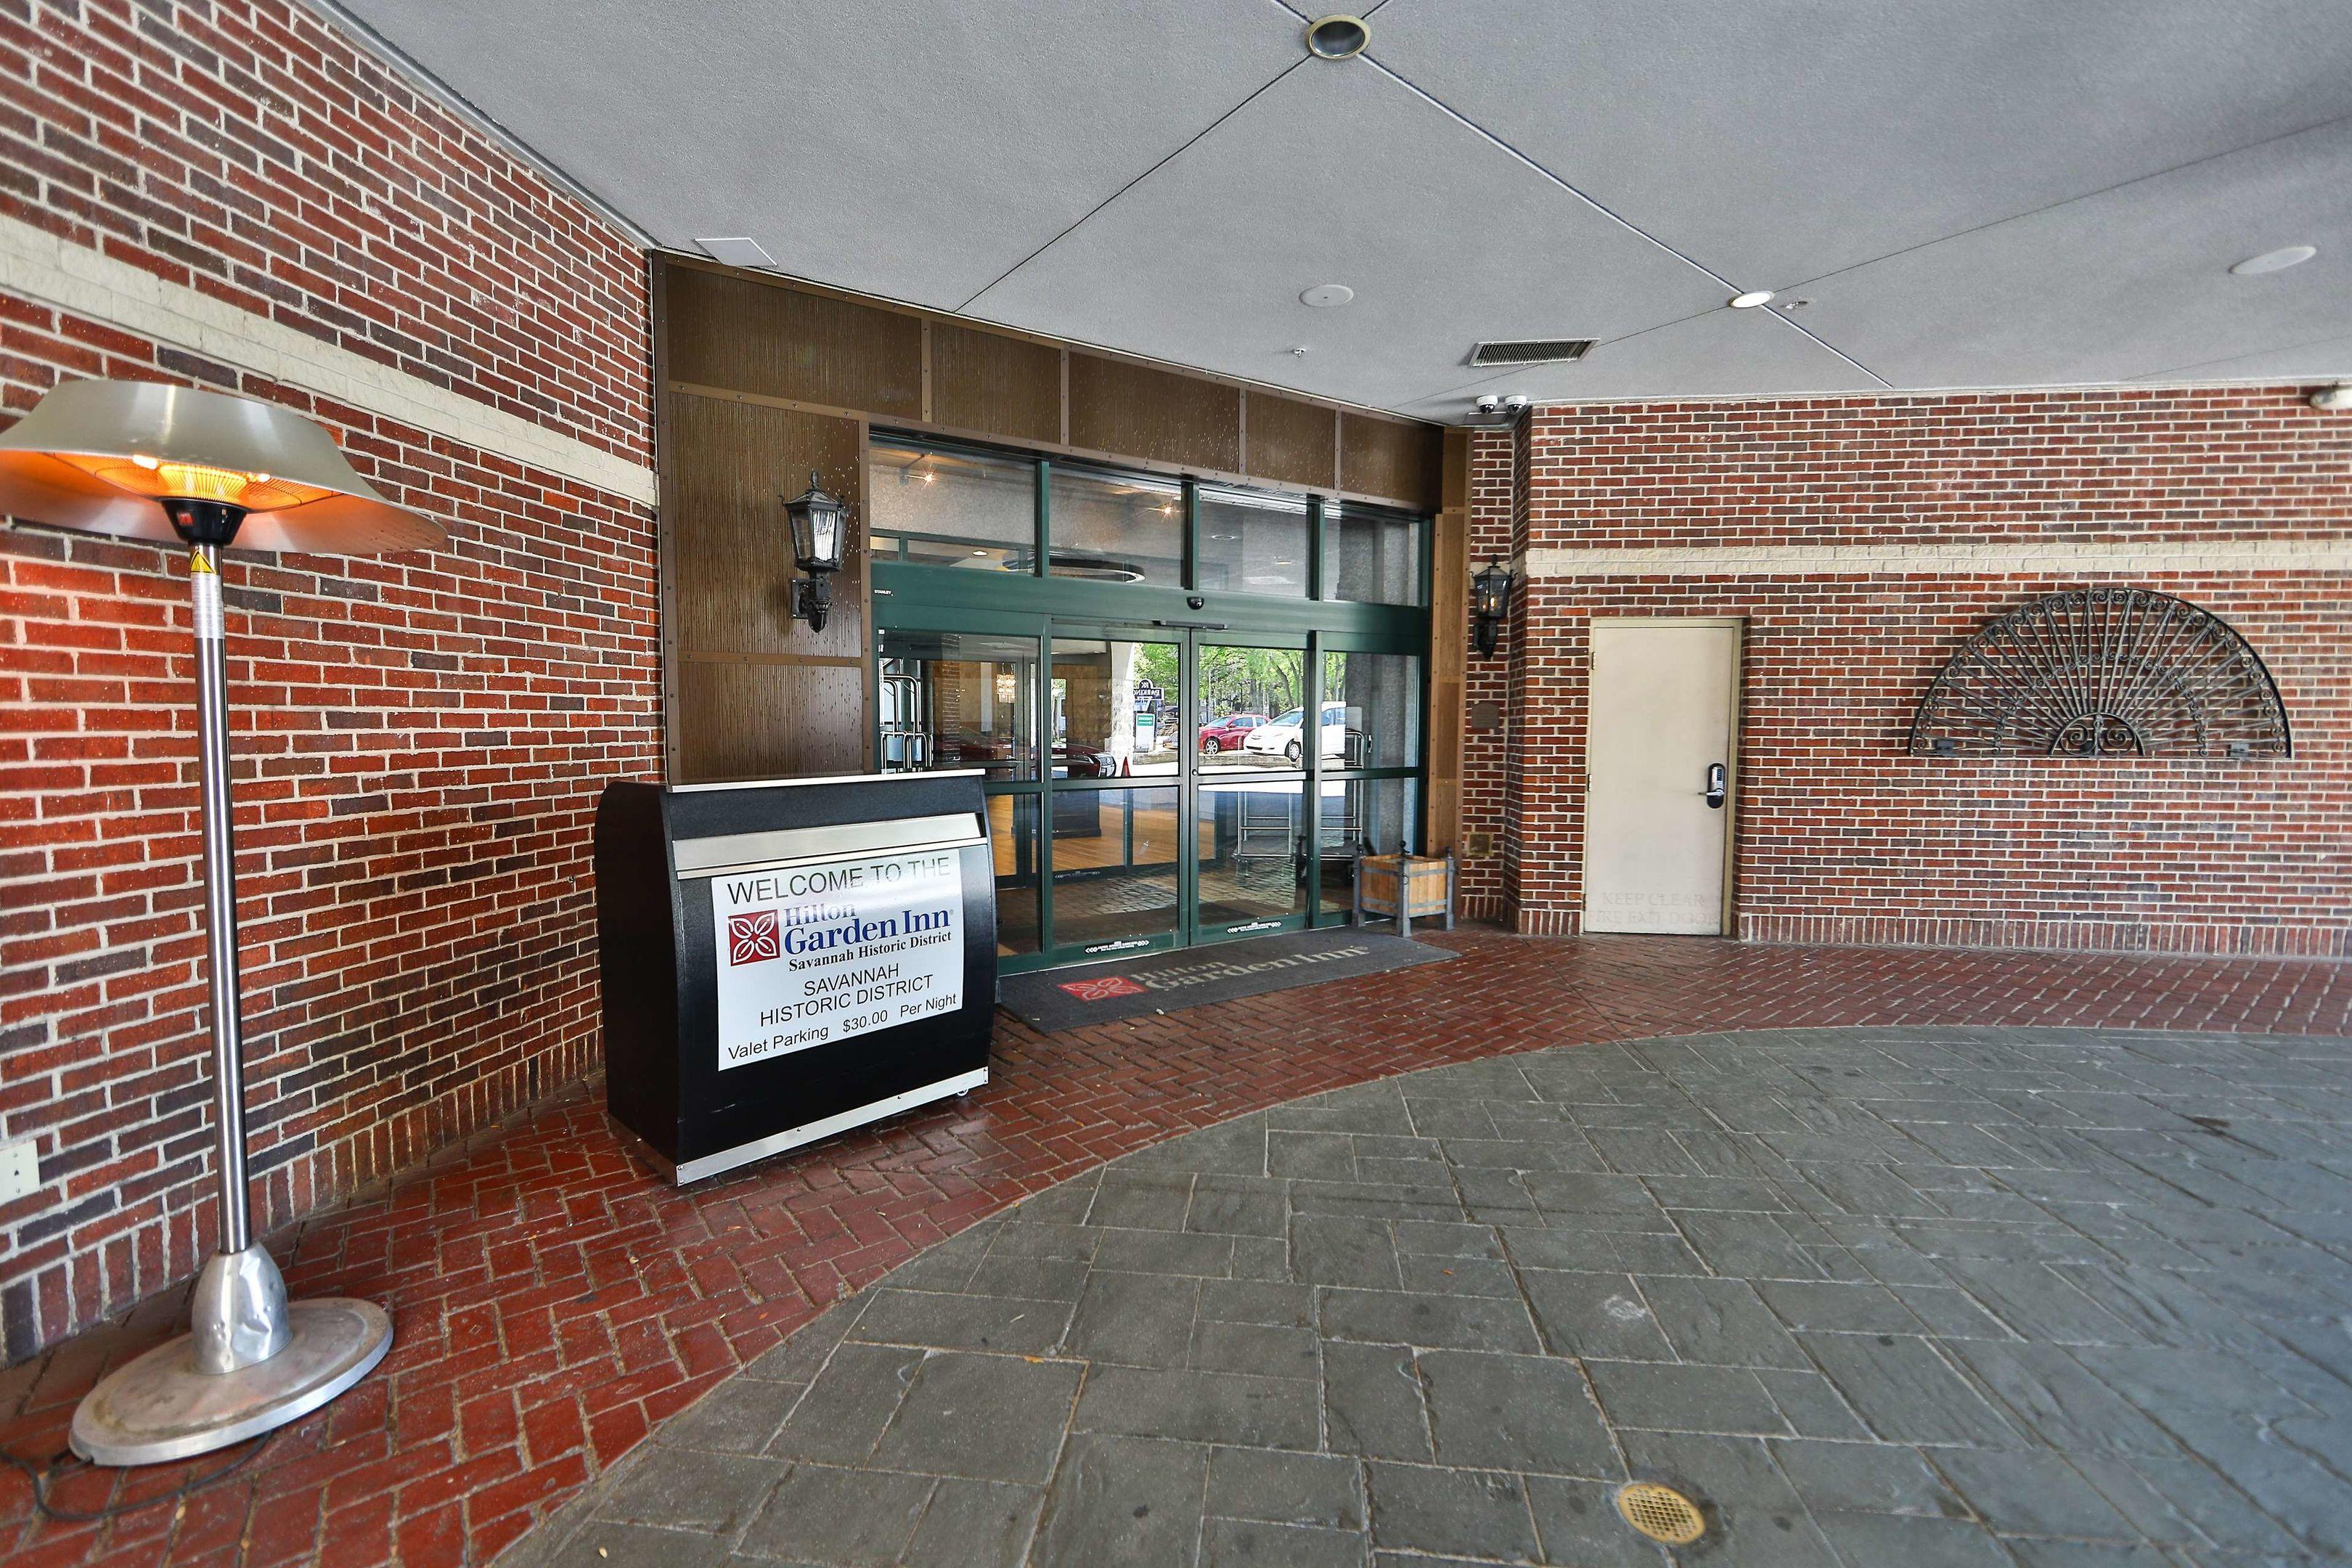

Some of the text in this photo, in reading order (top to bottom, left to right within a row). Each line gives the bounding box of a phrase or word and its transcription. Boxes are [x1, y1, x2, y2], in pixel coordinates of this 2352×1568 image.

[727, 857, 950, 905] WELCOME TO THE
[784, 902, 857, 928] Hilton
[1602, 892, 1705, 907] KEEP CLEAR
[784, 918, 898, 955] Garden
[789, 931, 951, 972] Savannah Historic District
[804, 963, 899, 996] SAVANNAH
[1131, 961, 1228, 981] Hilton
[1145, 956, 1299, 988] Garden
[761, 974, 933, 1027] HISTORIC DISTRICT
[728, 993, 957, 1060] Valet Parking $30.00 Per Night
